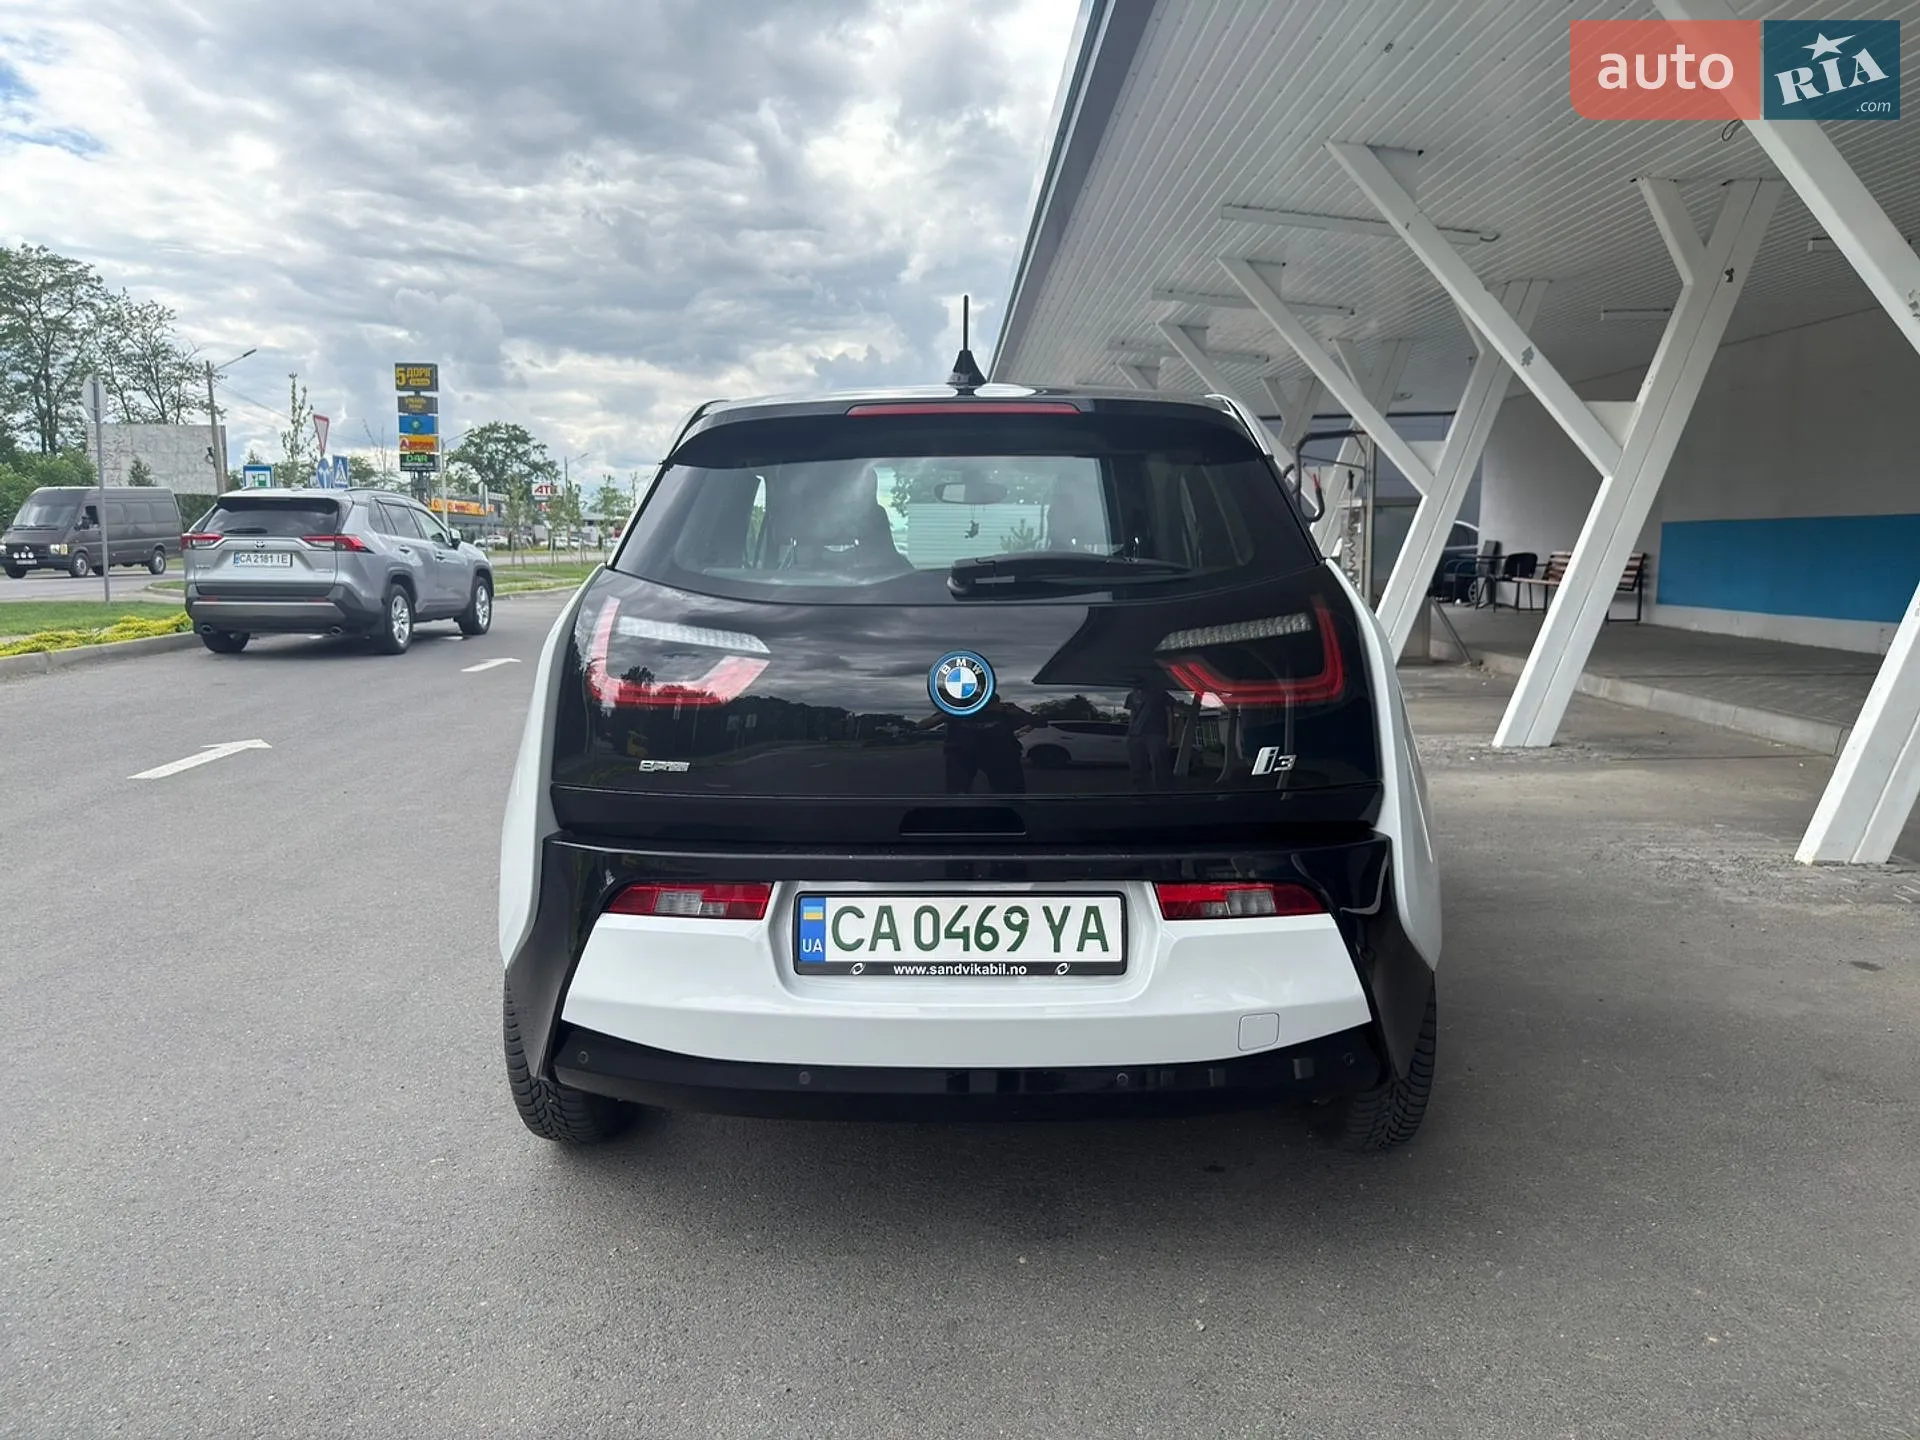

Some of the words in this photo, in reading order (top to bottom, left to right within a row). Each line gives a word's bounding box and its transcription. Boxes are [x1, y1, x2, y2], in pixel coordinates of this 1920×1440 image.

[396, 367, 407, 386] 5
[940, 658, 983, 675] BMW
[1251, 746, 1297, 776] i3
[831, 905, 901, 952] CA
[913, 905, 1030, 952] 0469
[1042, 905, 1110, 953] YA
[802, 938, 823, 952] UA
[893, 963, 1028, 976] www.sandvikabil.no
